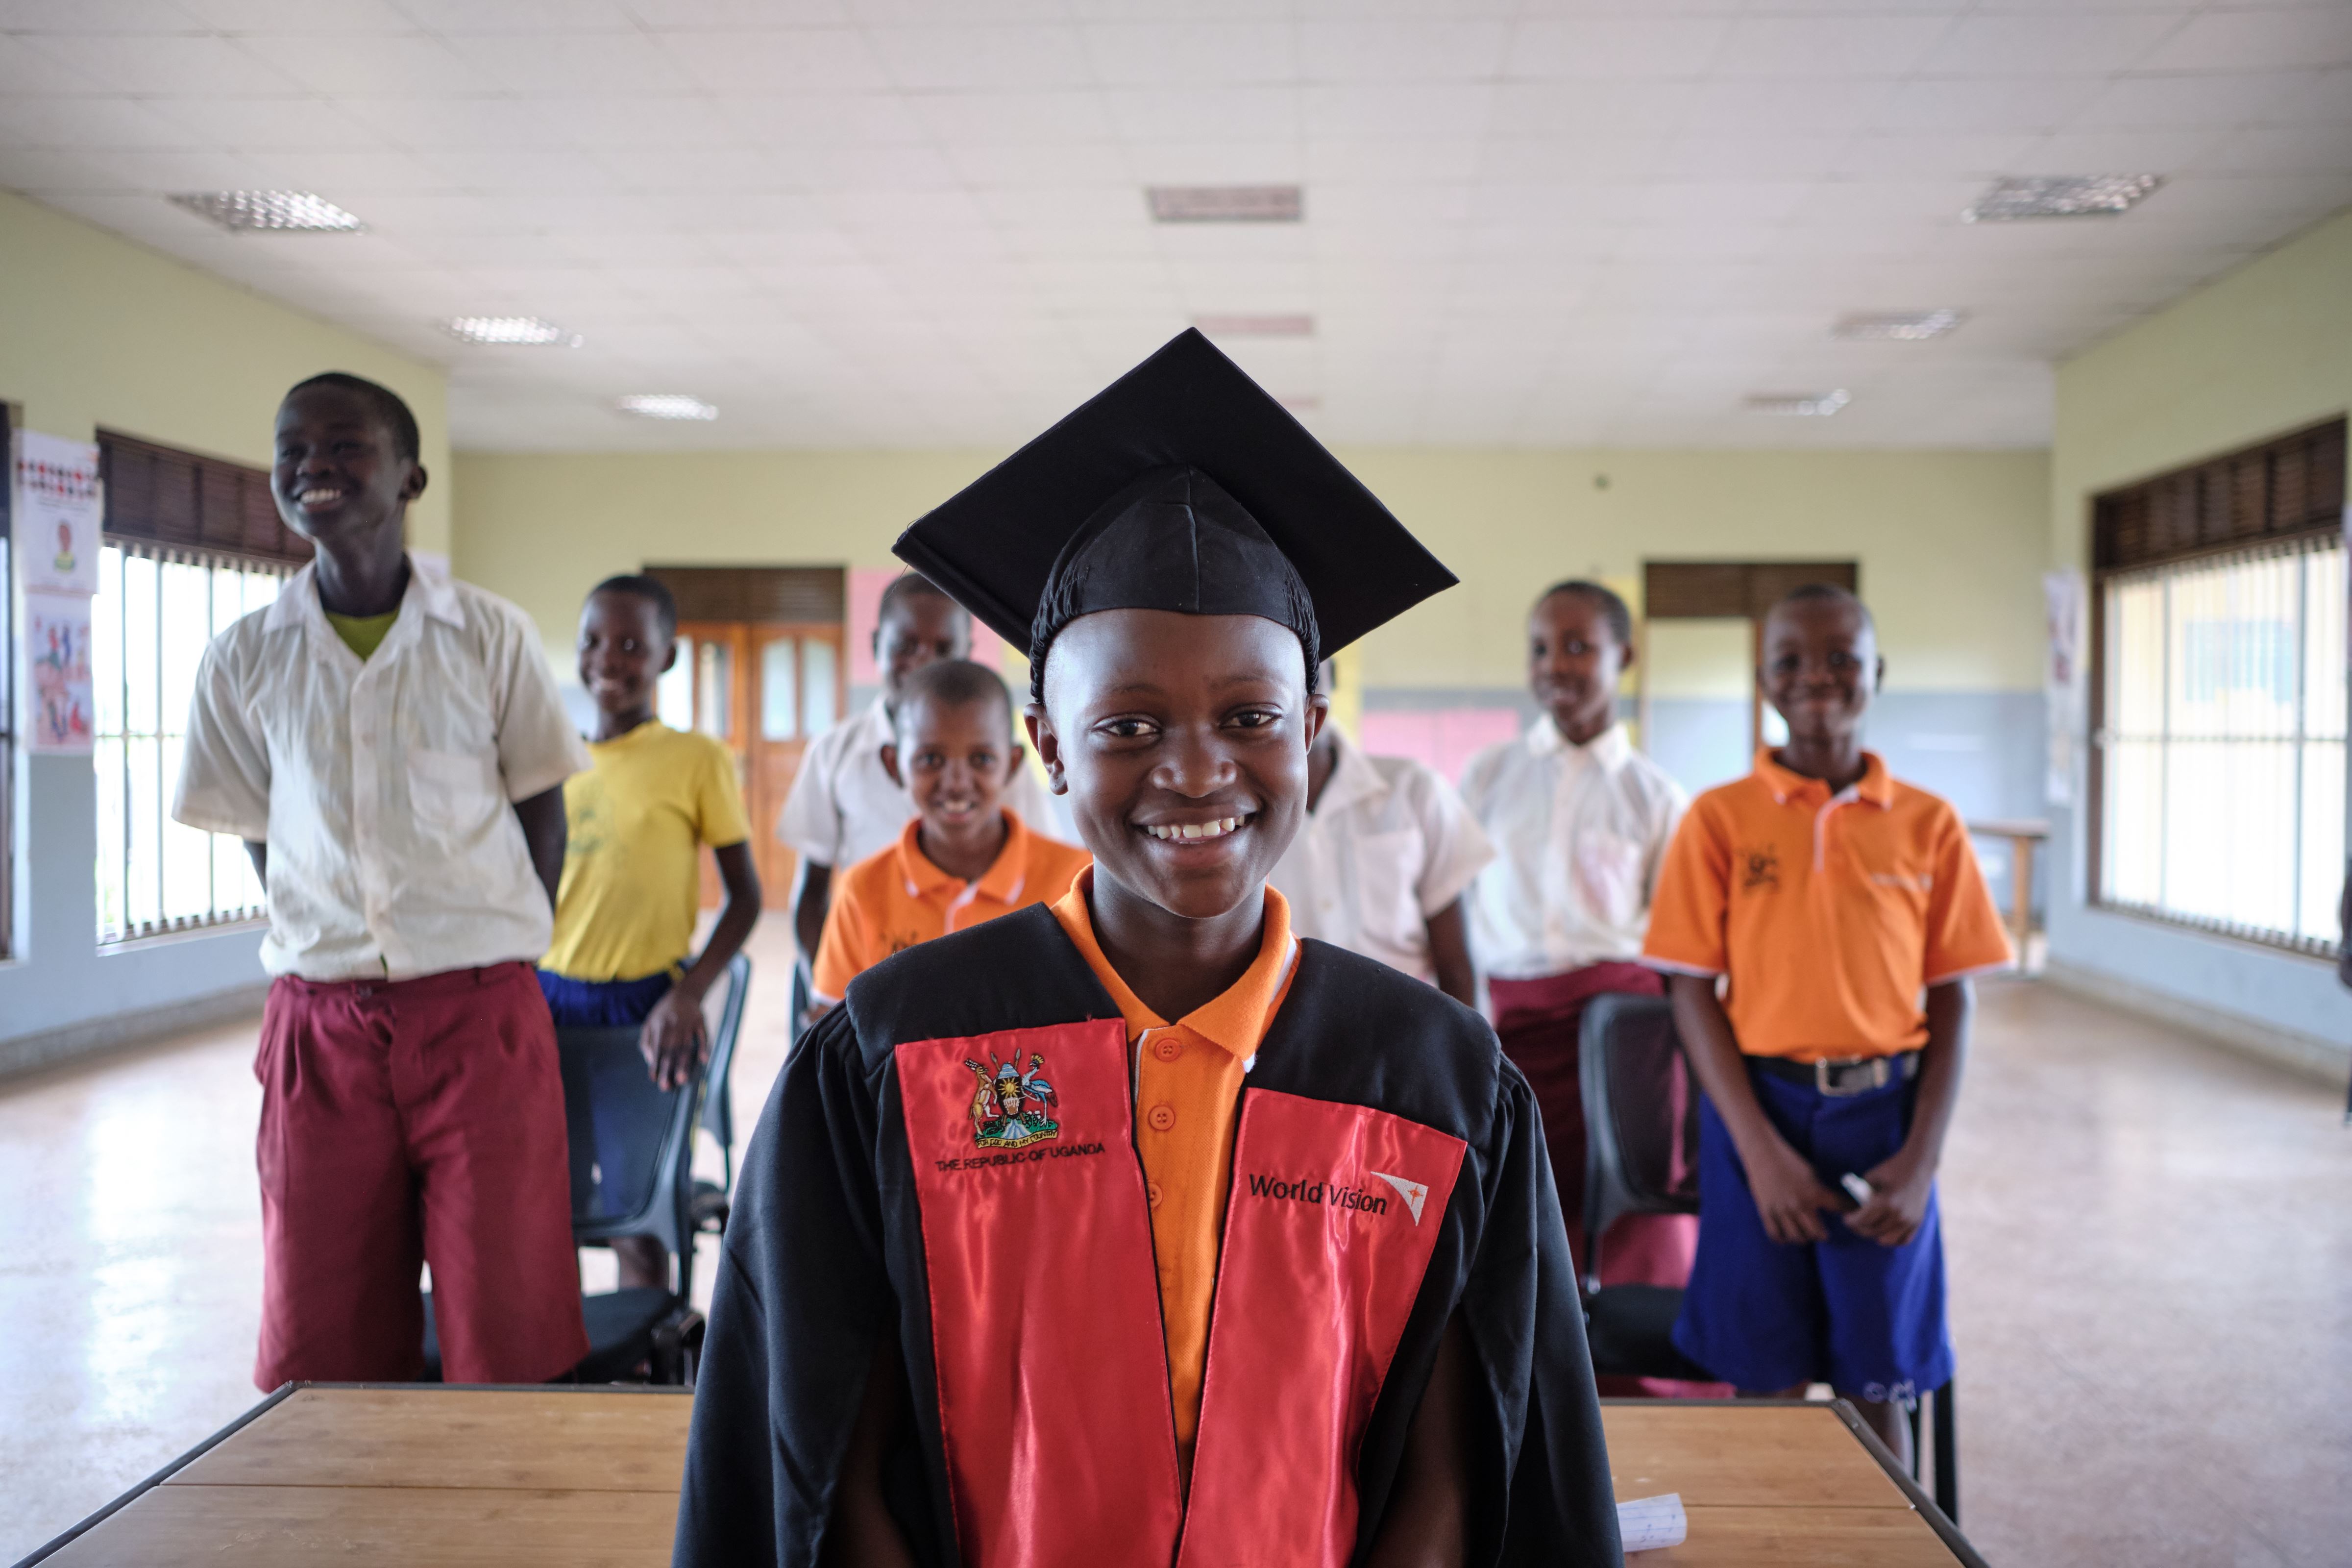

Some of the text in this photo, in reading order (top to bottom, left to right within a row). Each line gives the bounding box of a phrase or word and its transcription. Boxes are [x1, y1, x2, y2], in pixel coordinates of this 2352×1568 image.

[1030, 1131, 1055, 1143] COUNTRY
[935, 1142, 1105, 1171] THE REPUBLIC OF UGANDA
[1250, 1175, 1388, 1215] World Vision
